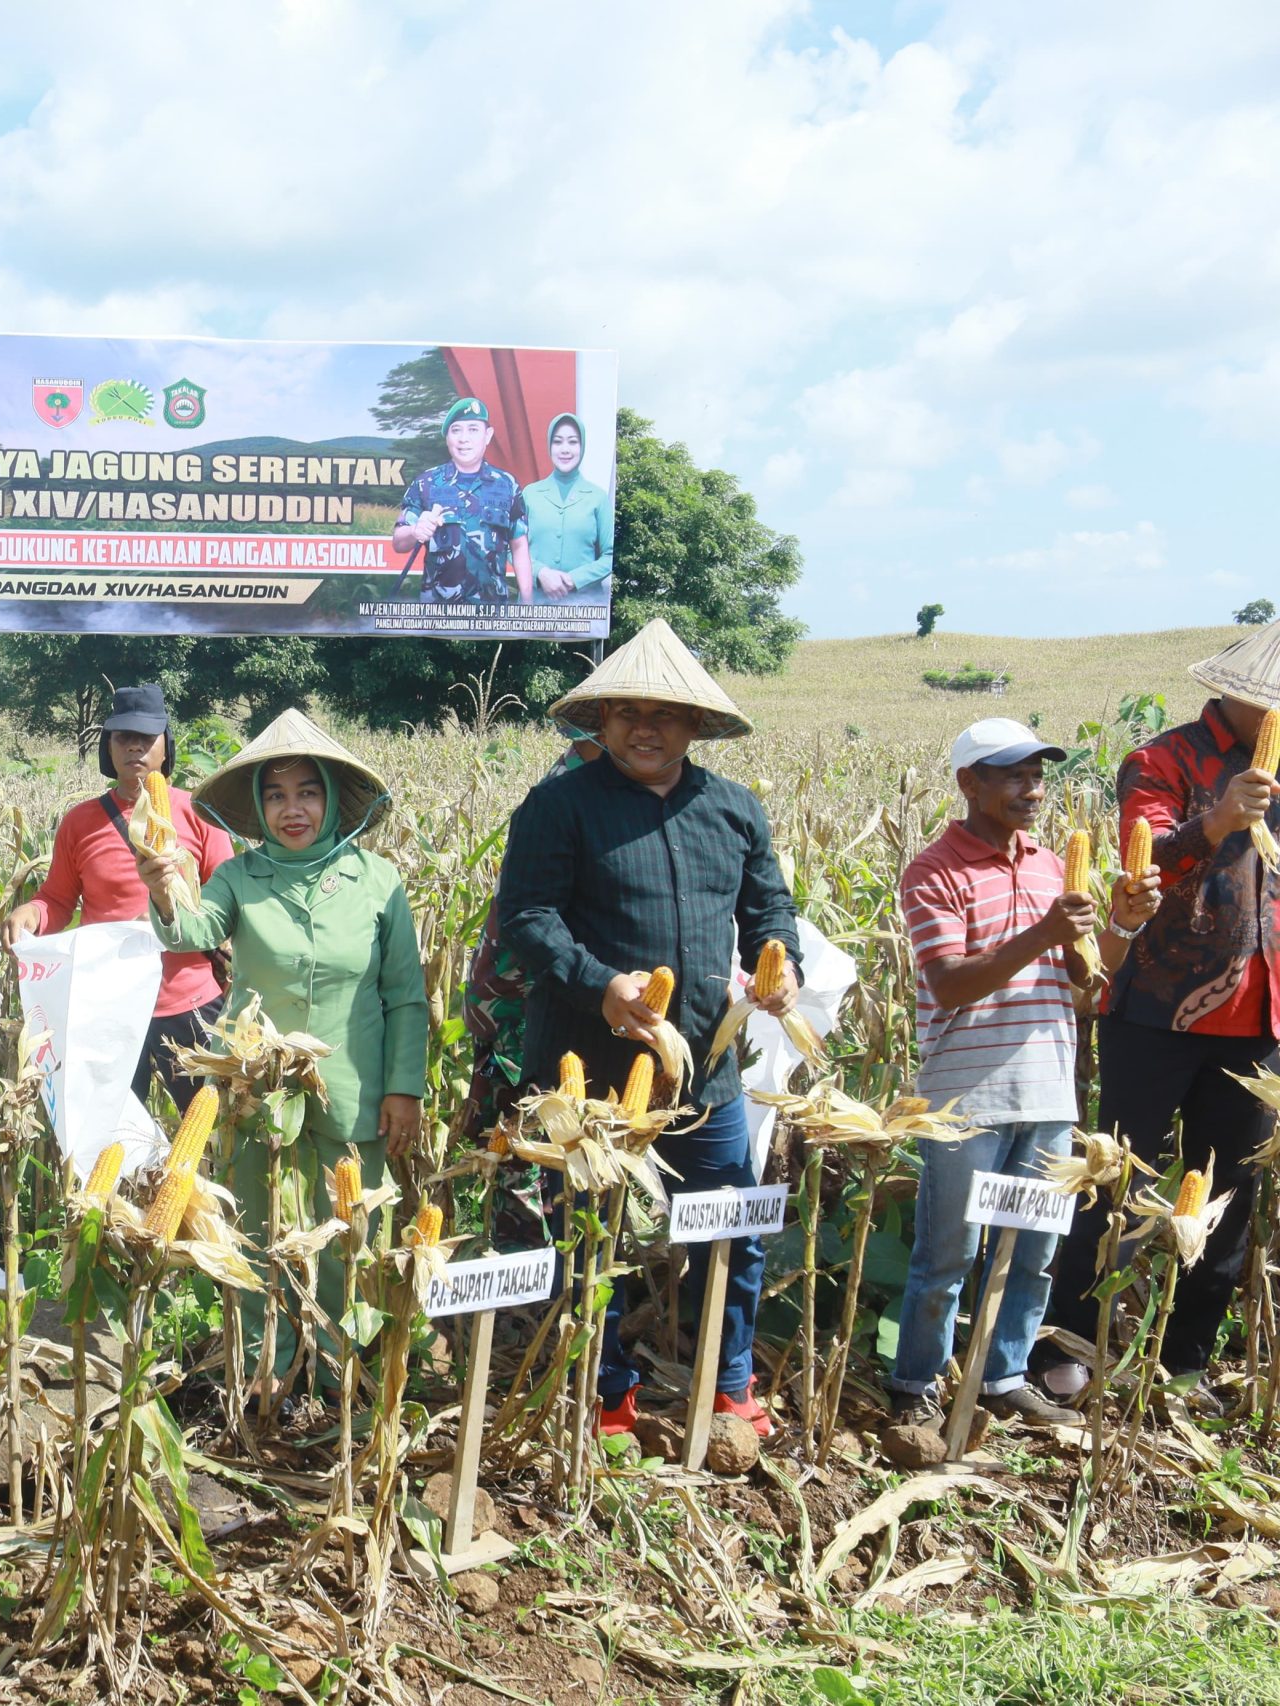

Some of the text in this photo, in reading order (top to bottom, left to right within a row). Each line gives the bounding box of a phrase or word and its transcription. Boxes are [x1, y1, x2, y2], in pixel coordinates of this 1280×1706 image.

[36, 379, 81, 387] HASANUDDIN
[49, 451, 202, 482] JAGUNG
[212, 454, 406, 486] SERENTAK
[12, 490, 353, 524] XIV/HASANUDDIN
[82, 538, 201, 565] KETAHANAN
[205, 540, 285, 567] PANGAN
[291, 542, 388, 568] NASIONAL
[103, 583, 290, 599] XIV/HASANUDDIN
[375, 618, 403, 629] PANGLIMA
[403, 619, 422, 630] KODAM
[423, 619, 470, 631] XIV/HASANUDDIN
[475, 620, 492, 631] KETUA
[492, 620, 511, 632] PERSIT
[523, 621, 545, 632] DAERAH
[545, 621, 591, 633] XIV/HASANUDDIN
[389, 603, 400, 616] TNI
[401, 604, 425, 617] BOBBY
[425, 604, 446, 617] RINAL
[446, 604, 479, 618] MAKMUN,
[500, 605, 505, 618] &
[507, 605, 520, 618] IBU
[520, 605, 533, 618] MIA
[533, 606, 557, 619] BOBBY
[557, 606, 578, 619] RINAL
[578, 606, 607, 620] MAKMUN
[676, 1202, 721, 1232] KADISTAN
[743, 1197, 782, 1227] TAKALAR
[978, 1181, 1071, 1221] CAMAT POLUT
[449, 1270, 495, 1306] BUPATI
[495, 1261, 550, 1298] TAKALAR
